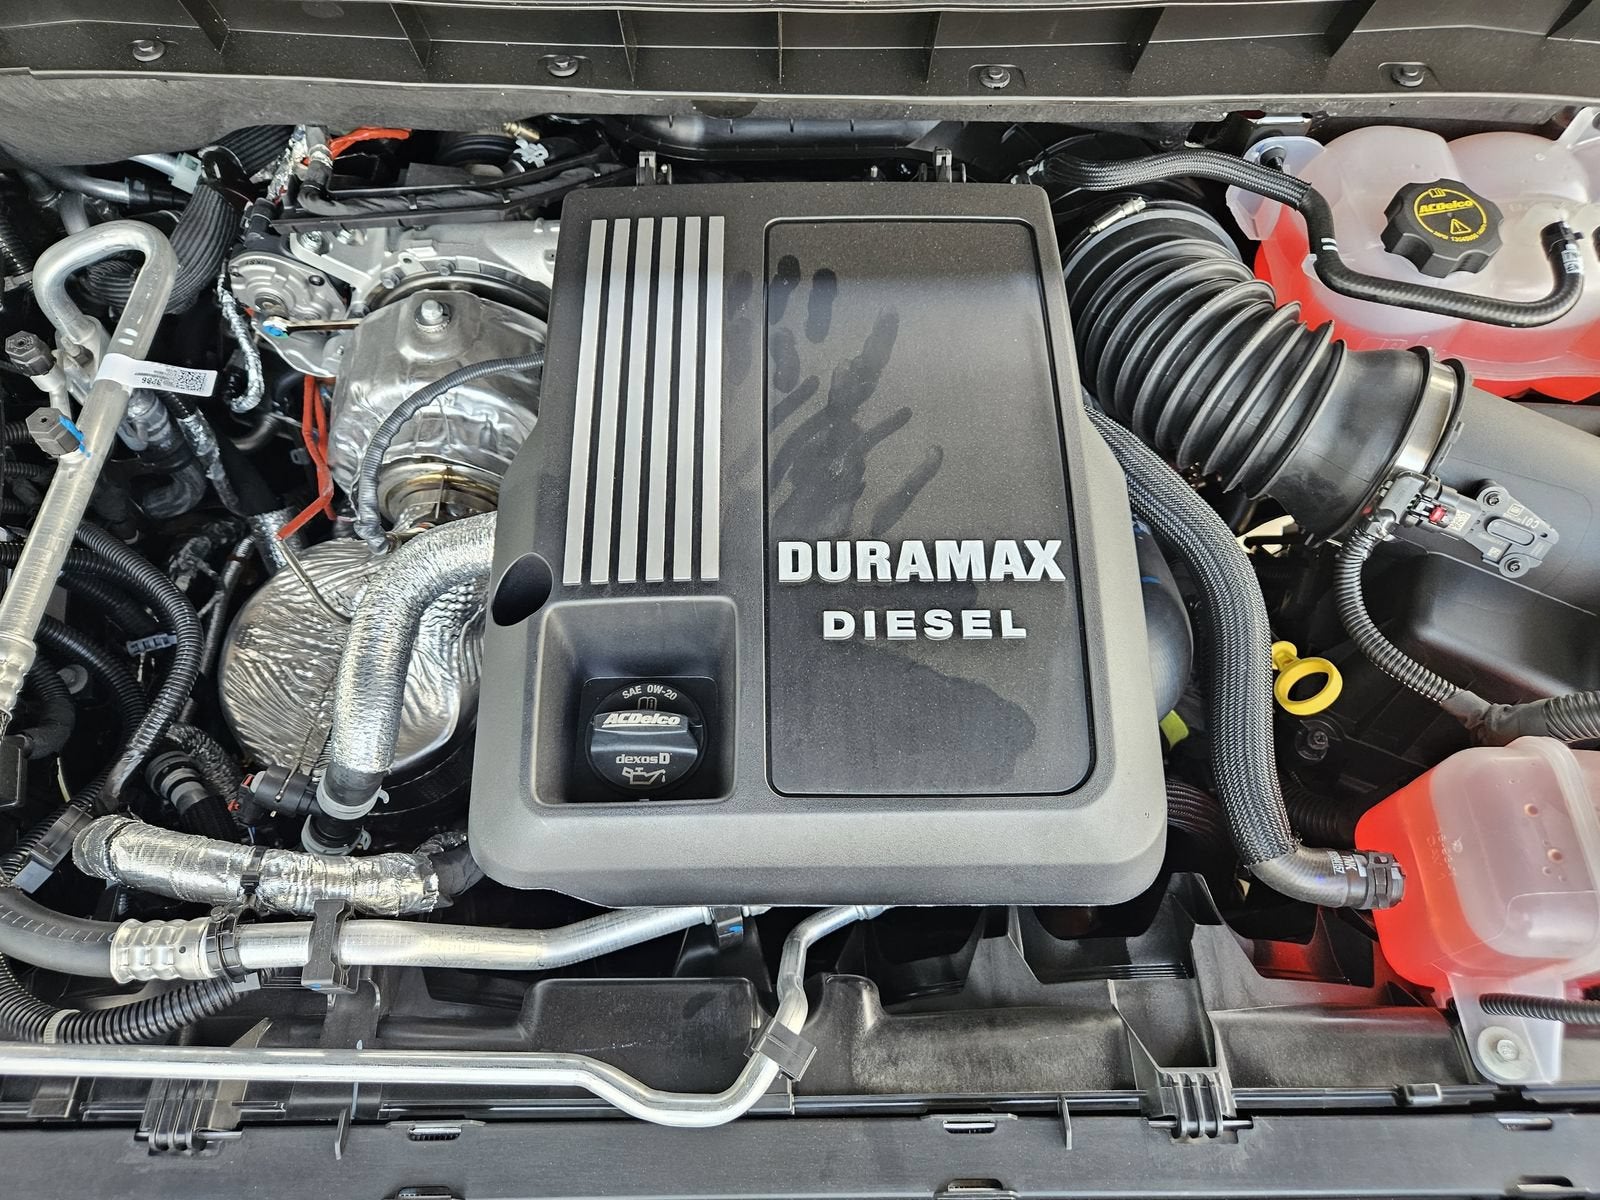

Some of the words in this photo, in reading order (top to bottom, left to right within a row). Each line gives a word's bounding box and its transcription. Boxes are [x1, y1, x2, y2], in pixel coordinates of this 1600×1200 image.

[1419, 199, 1474, 214] ACDelco
[778, 539, 1066, 582] DURAMAX
[823, 609, 1027, 640] DIESEL
[622, 685, 642, 699] SAE
[646, 684, 678, 701] 0W-20
[603, 713, 681, 726] ACDelco
